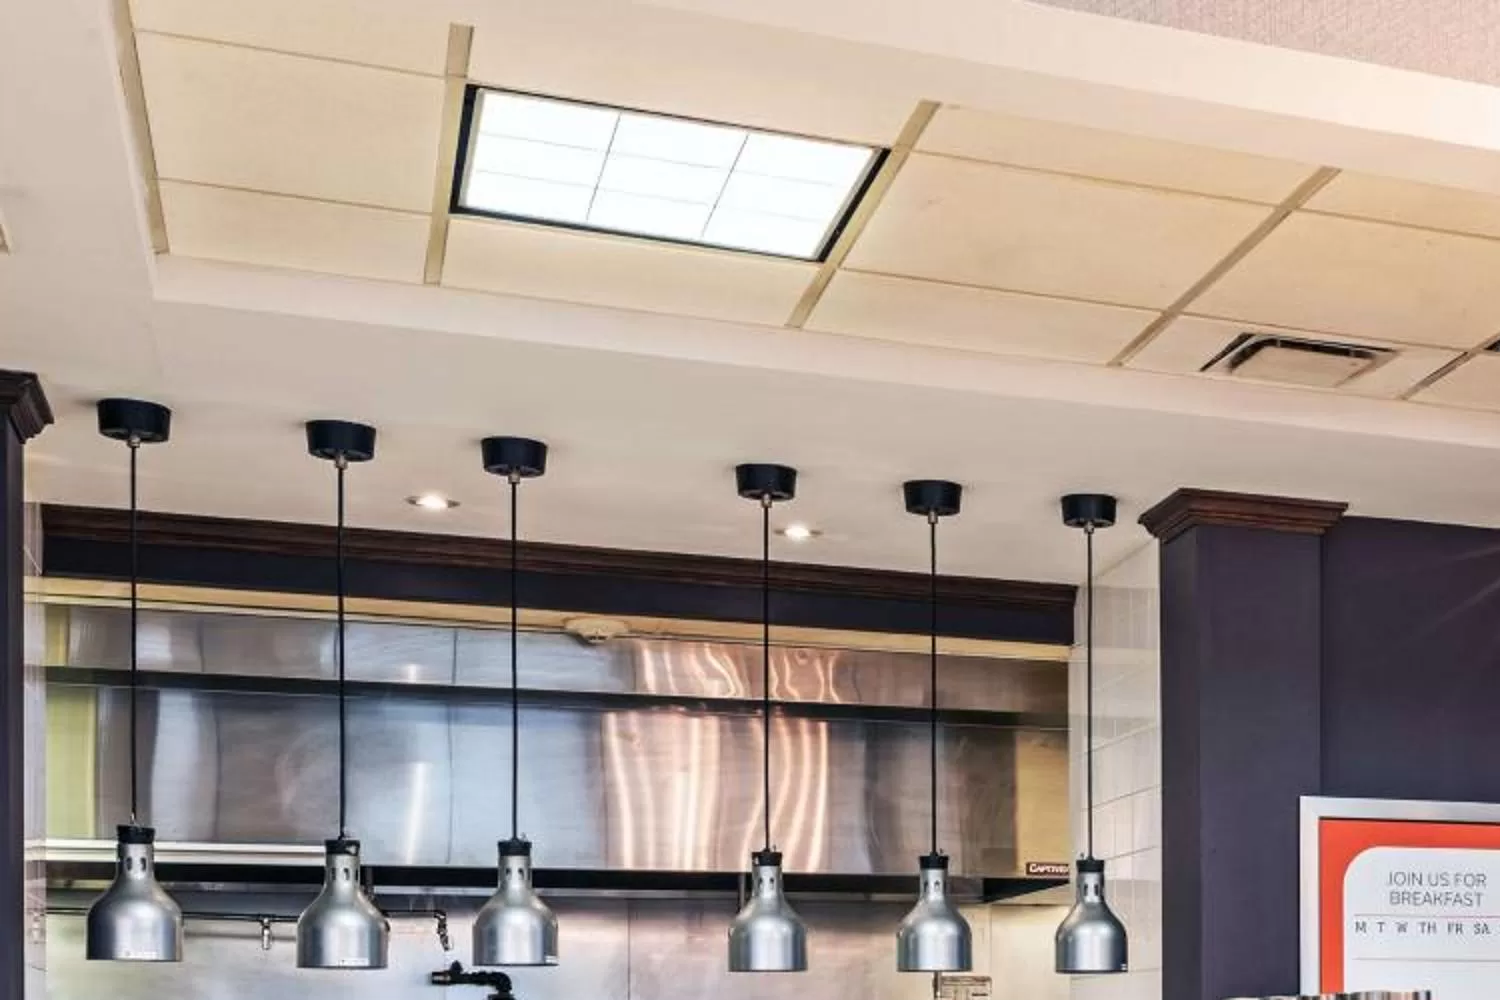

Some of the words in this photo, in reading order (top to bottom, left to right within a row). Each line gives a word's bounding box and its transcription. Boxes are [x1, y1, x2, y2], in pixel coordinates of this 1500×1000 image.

[1389, 871, 1423, 886] JOIN
[1428, 872, 1449, 887] US
[1454, 873, 1487, 888] FOR
[1389, 891, 1483, 907] BREAKFAST
[1355, 921, 1367, 934] M
[1377, 921, 1386, 933] T
[1395, 921, 1408, 933] W
[1420, 922, 1437, 934] TH
[1448, 922, 1463, 935] FR
[1473, 923, 1490, 935] SA
